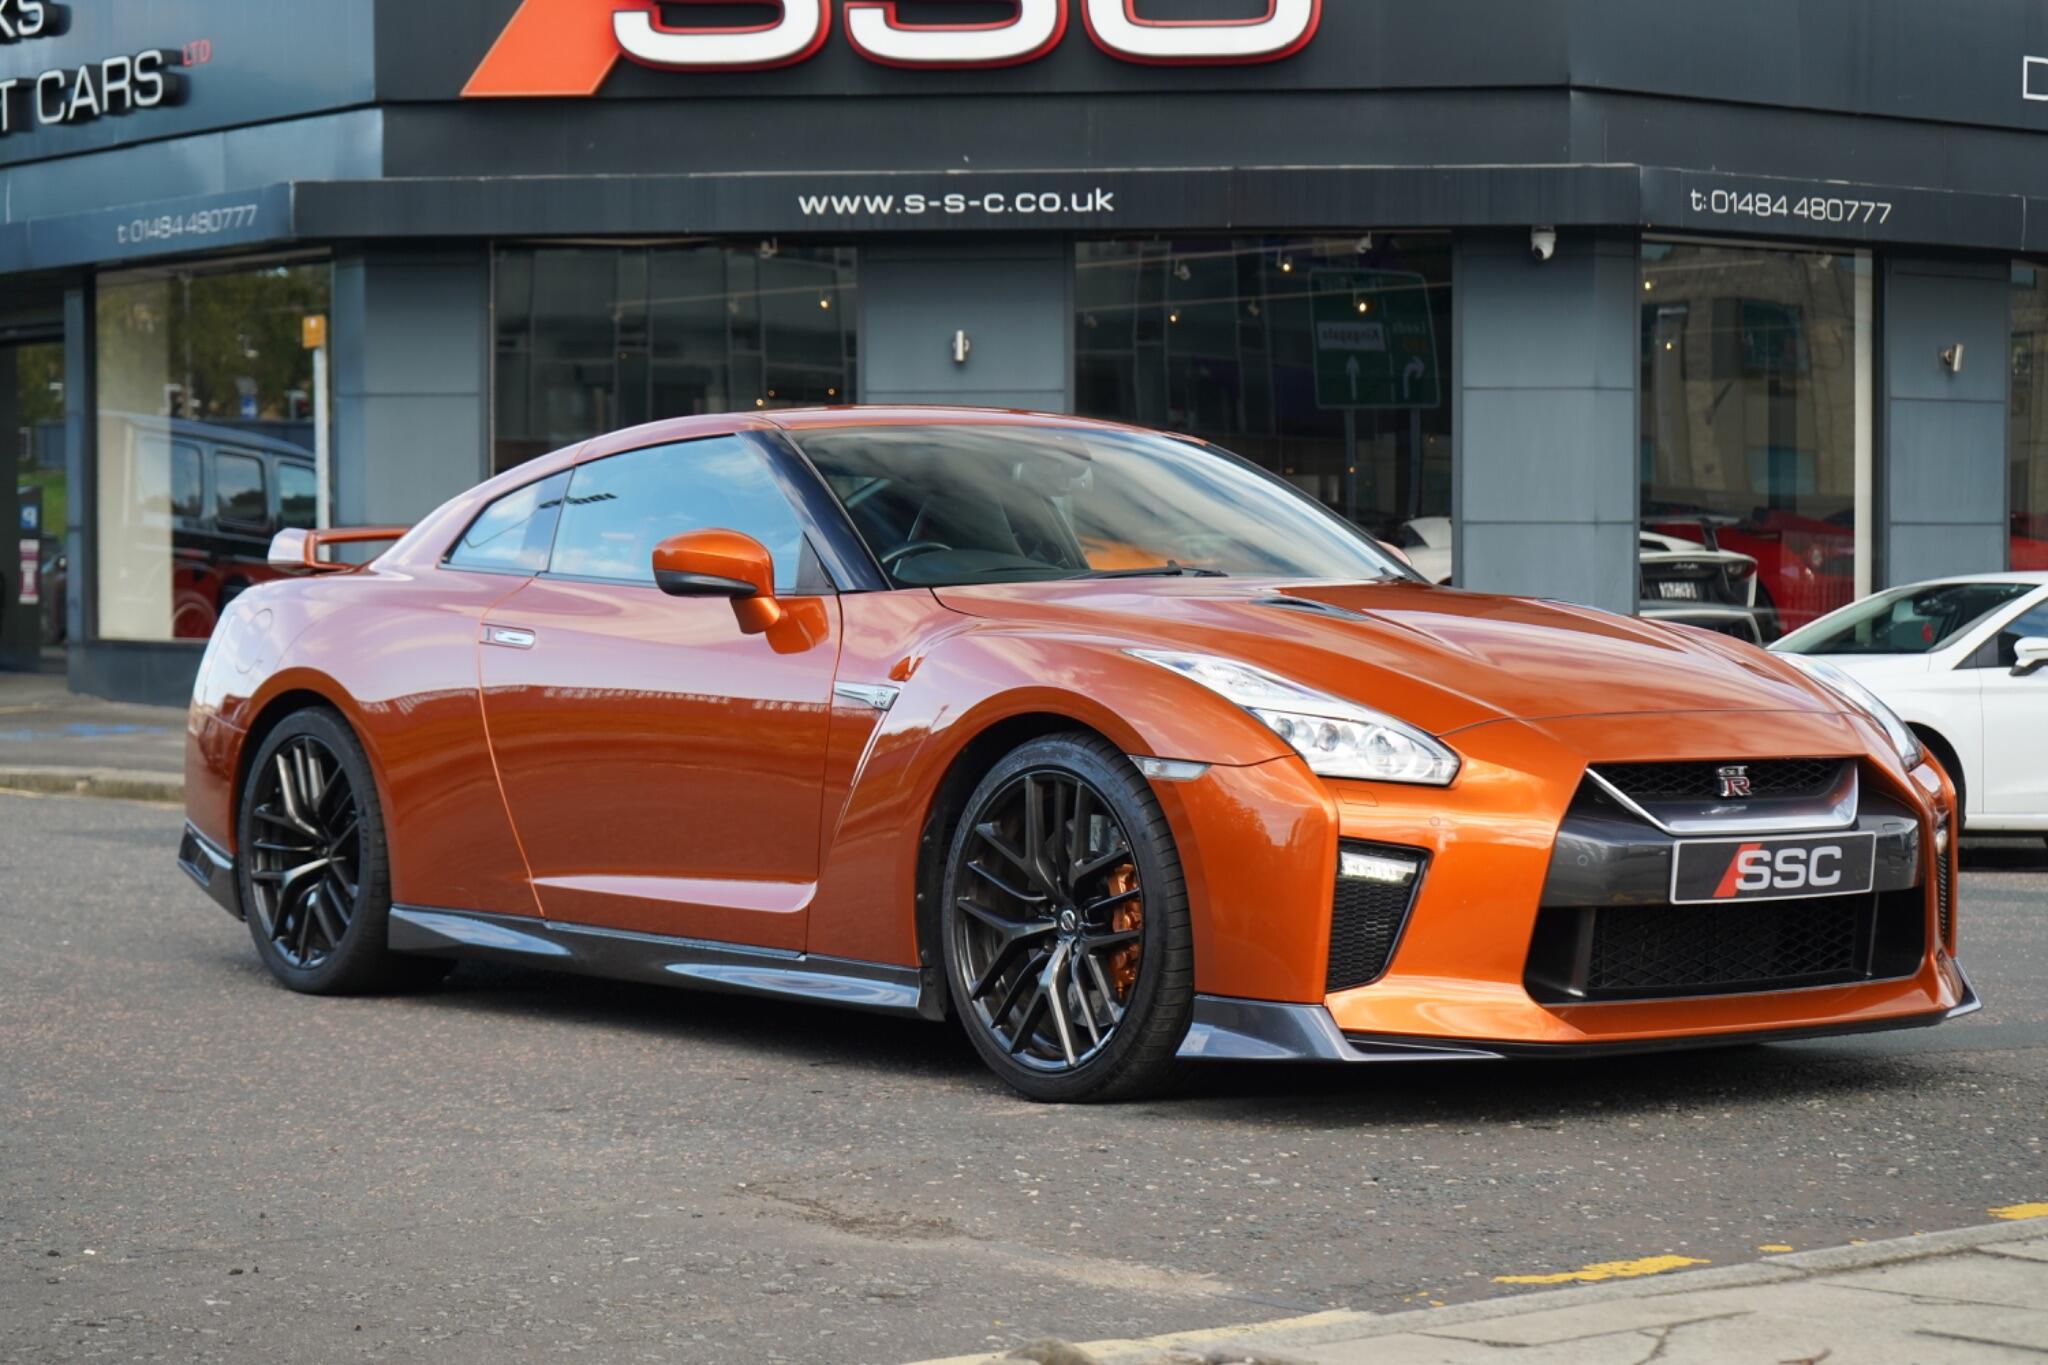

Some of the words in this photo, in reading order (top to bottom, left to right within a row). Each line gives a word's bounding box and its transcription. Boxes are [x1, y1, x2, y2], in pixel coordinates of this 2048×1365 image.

[36, 49, 163, 125] CARS
[798, 187, 1115, 215] www.s-s-c.co.uk
[1793, 197, 1892, 224] 480777
[184, 204, 258, 234] 480777
[1735, 845, 1842, 890] SSC
